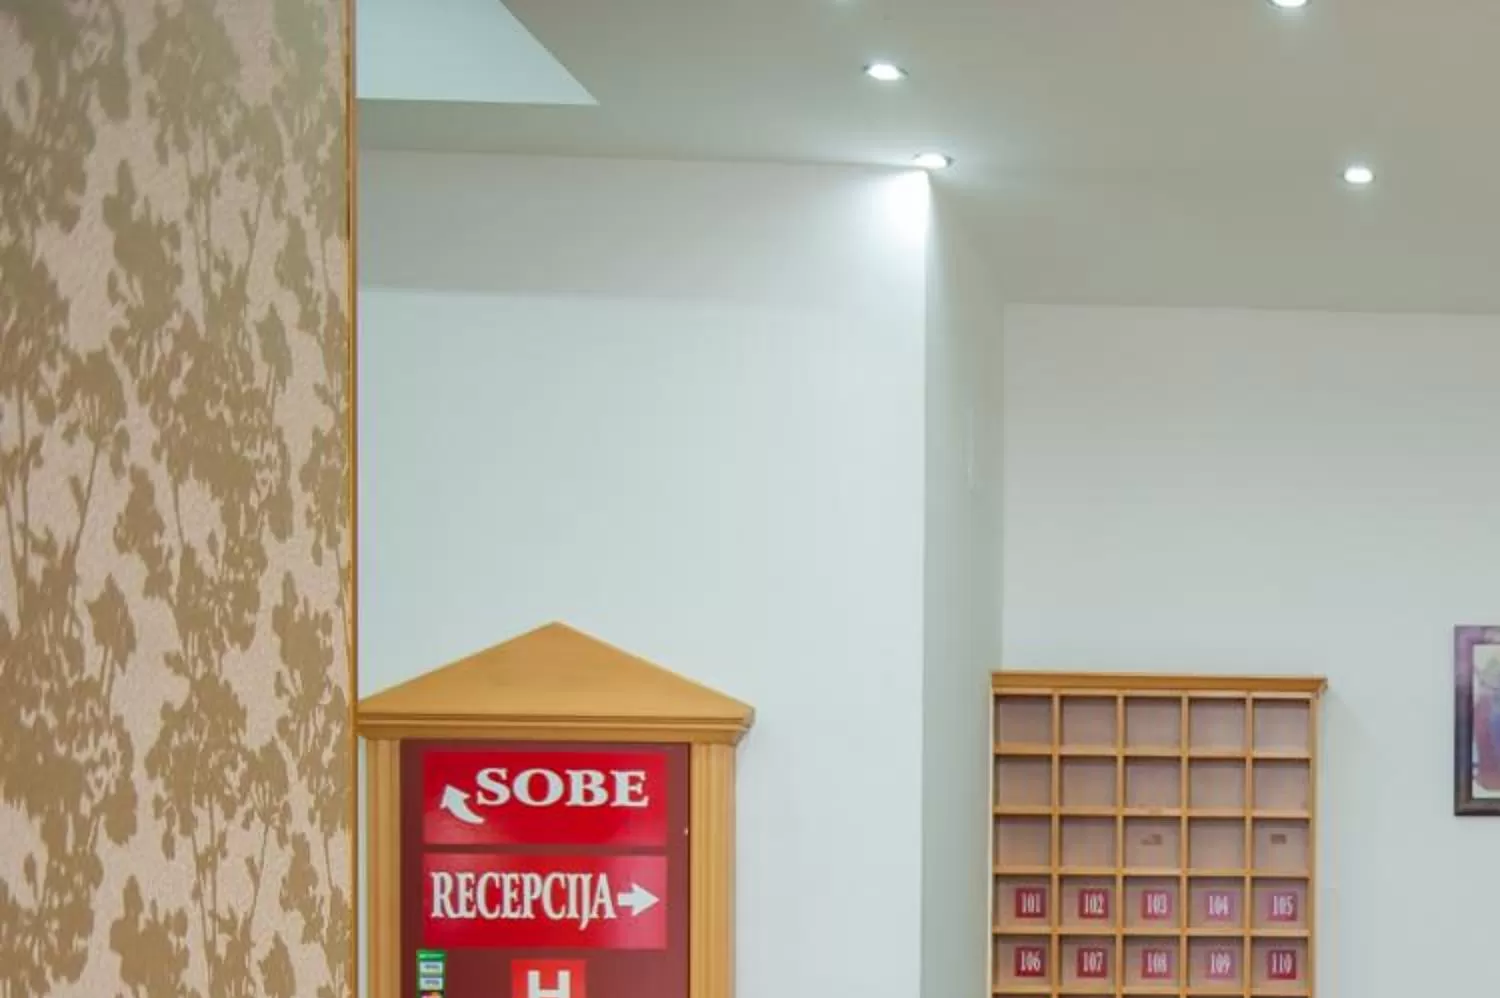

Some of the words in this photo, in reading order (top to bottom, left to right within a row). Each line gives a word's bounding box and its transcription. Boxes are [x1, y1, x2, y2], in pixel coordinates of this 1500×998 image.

[475, 767, 649, 808] SOBE
[431, 871, 617, 931] RECEPCIJA
[1021, 891, 1041, 914] 101
[1083, 892, 1105, 915] 102
[1146, 893, 1168, 915] 103
[1208, 895, 1230, 916] 104
[1272, 895, 1294, 917] 105
[1020, 950, 1041, 973] 106
[1083, 950, 1105, 973] 107
[1146, 951, 1168, 973] 108
[1210, 951, 1231, 974] 109
[1271, 952, 1293, 974] 110
